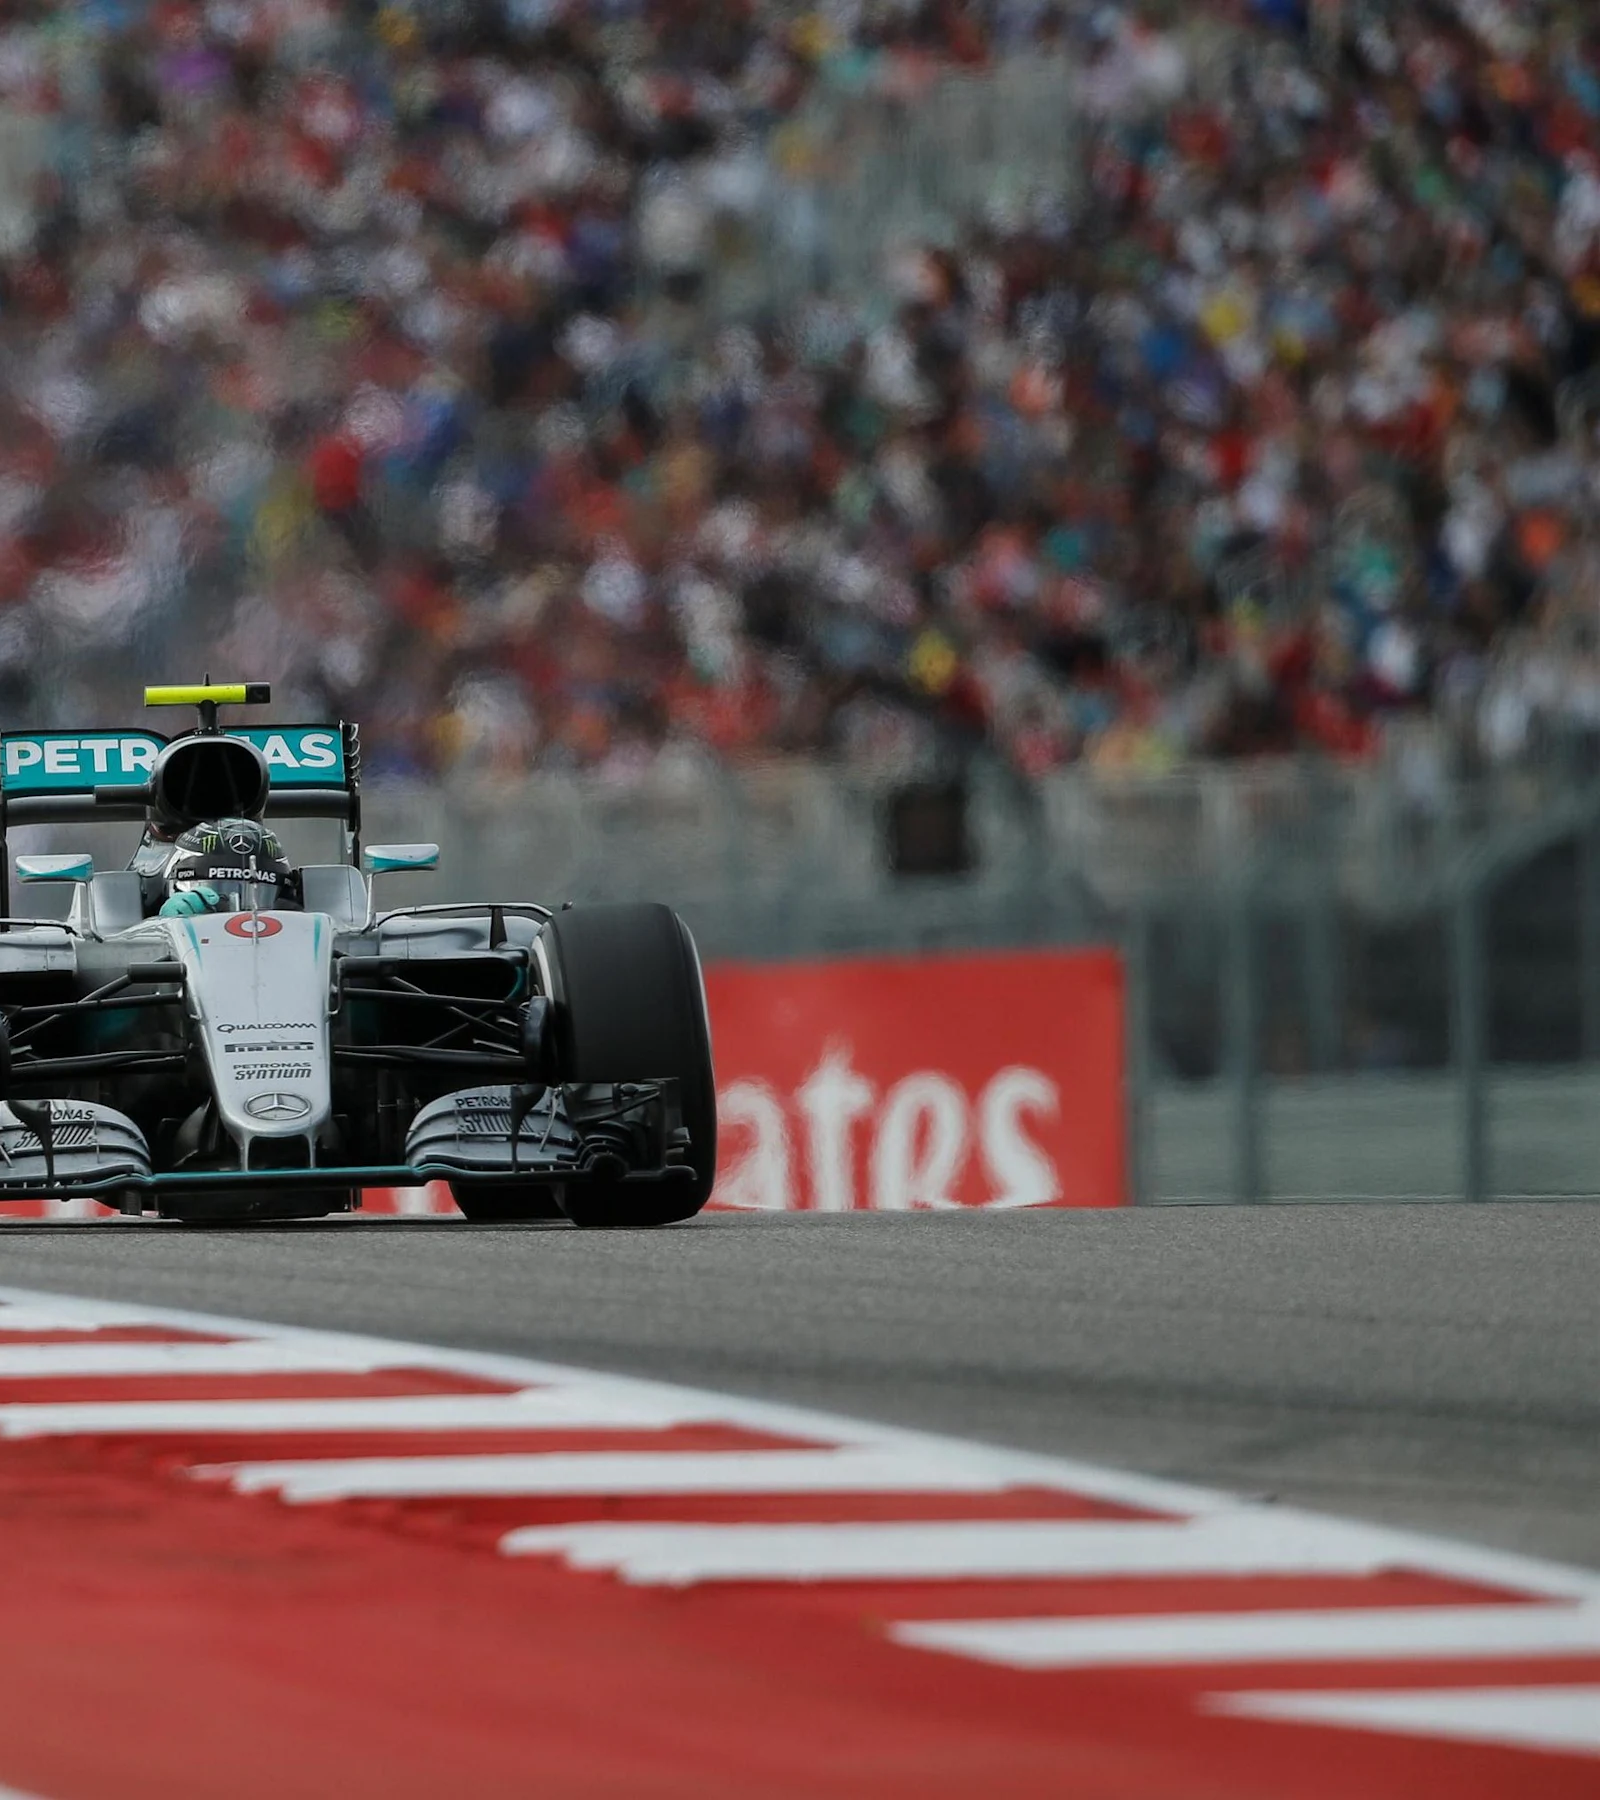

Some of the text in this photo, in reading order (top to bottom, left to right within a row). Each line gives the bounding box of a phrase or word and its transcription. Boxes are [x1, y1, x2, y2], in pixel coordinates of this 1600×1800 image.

[5, 733, 337, 775] PETRAS
[217, 1023, 317, 1033] QUALCOMM
[225, 1041, 314, 1053] PIRELLI
[235, 1068, 312, 1080] SYNTIUM
[455, 1096, 511, 1108] PETRON
